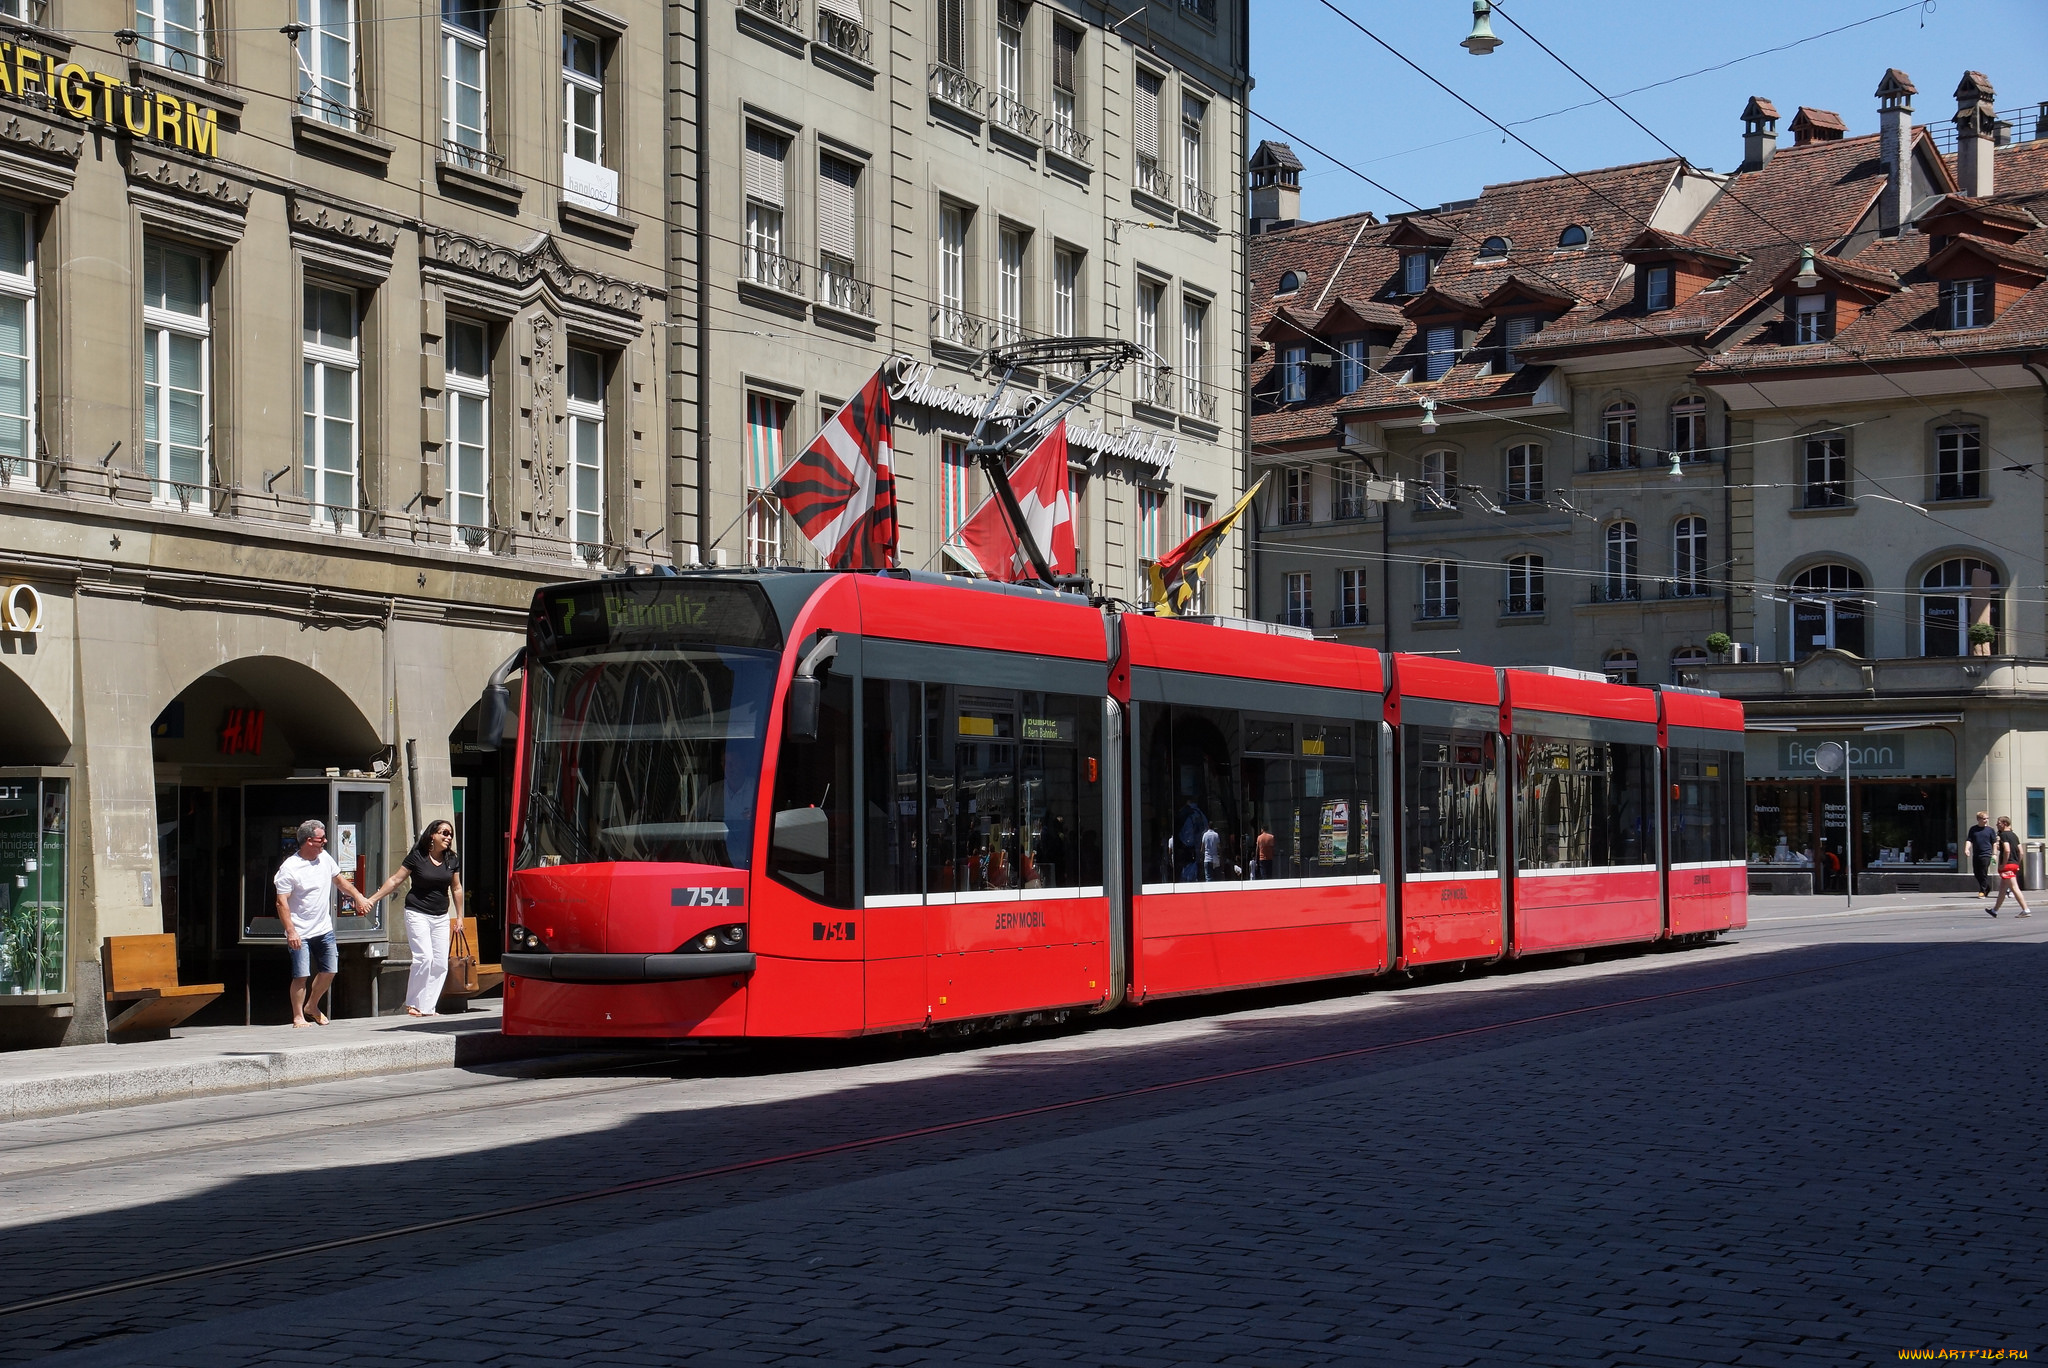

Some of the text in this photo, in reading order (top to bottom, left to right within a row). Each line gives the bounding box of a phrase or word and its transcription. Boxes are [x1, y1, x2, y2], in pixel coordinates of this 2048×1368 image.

[555, 594, 708, 635] 7 Bümpliz
[1789, 742, 1893, 765] fieann
[1824, 803, 1847, 811] fielman
[1824, 811, 1847, 819] fielman
[1824, 819, 1847, 828] fielman
[687, 887, 729, 907] 754
[995, 911, 1046, 930] BERNMOBIL
[821, 922, 847, 940] 754
